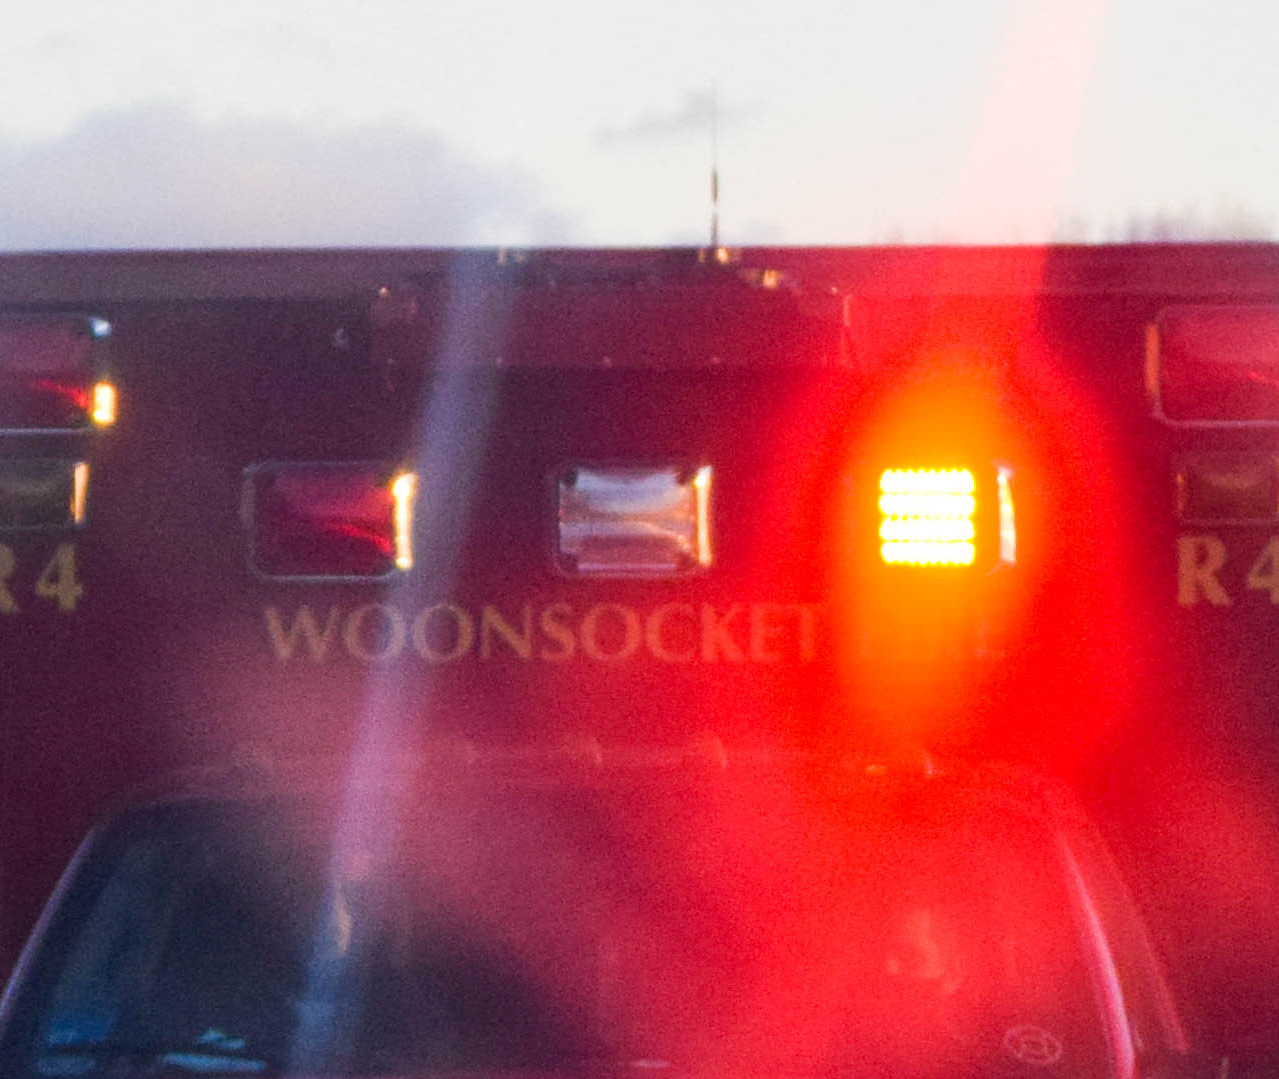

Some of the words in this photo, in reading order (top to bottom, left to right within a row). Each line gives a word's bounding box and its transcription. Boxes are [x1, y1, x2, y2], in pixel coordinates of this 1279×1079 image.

[35, 543, 83, 614] 4
[1175, 535, 1230, 607] R
[265, 604, 821, 664] WOONSOCKET
